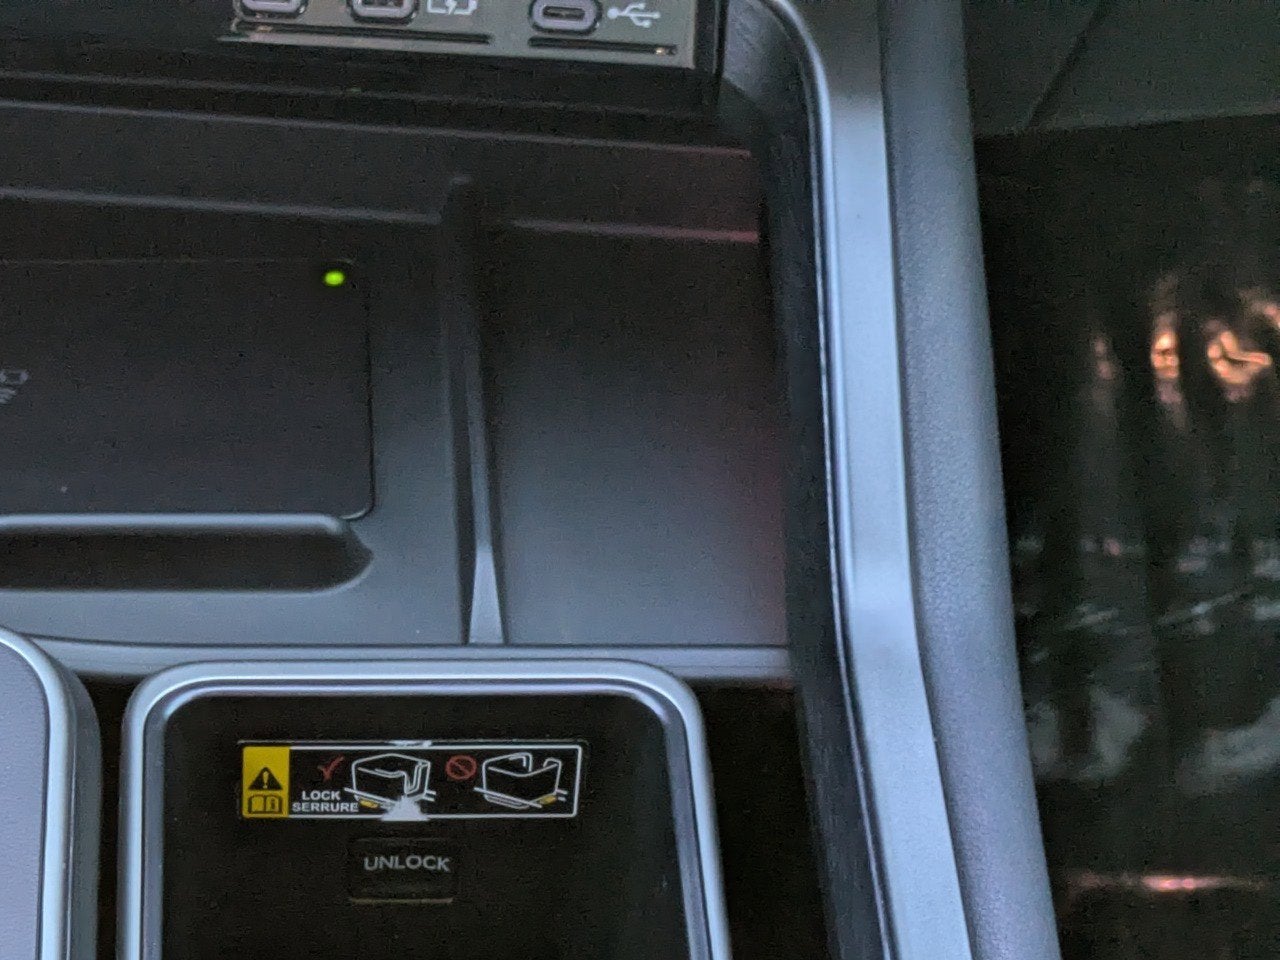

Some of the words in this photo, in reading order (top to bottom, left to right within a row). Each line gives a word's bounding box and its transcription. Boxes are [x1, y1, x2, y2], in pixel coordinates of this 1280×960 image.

[301, 790, 341, 801] LOCK
[292, 802, 359, 813] SERRURE
[363, 855, 450, 872] UNLOCK
